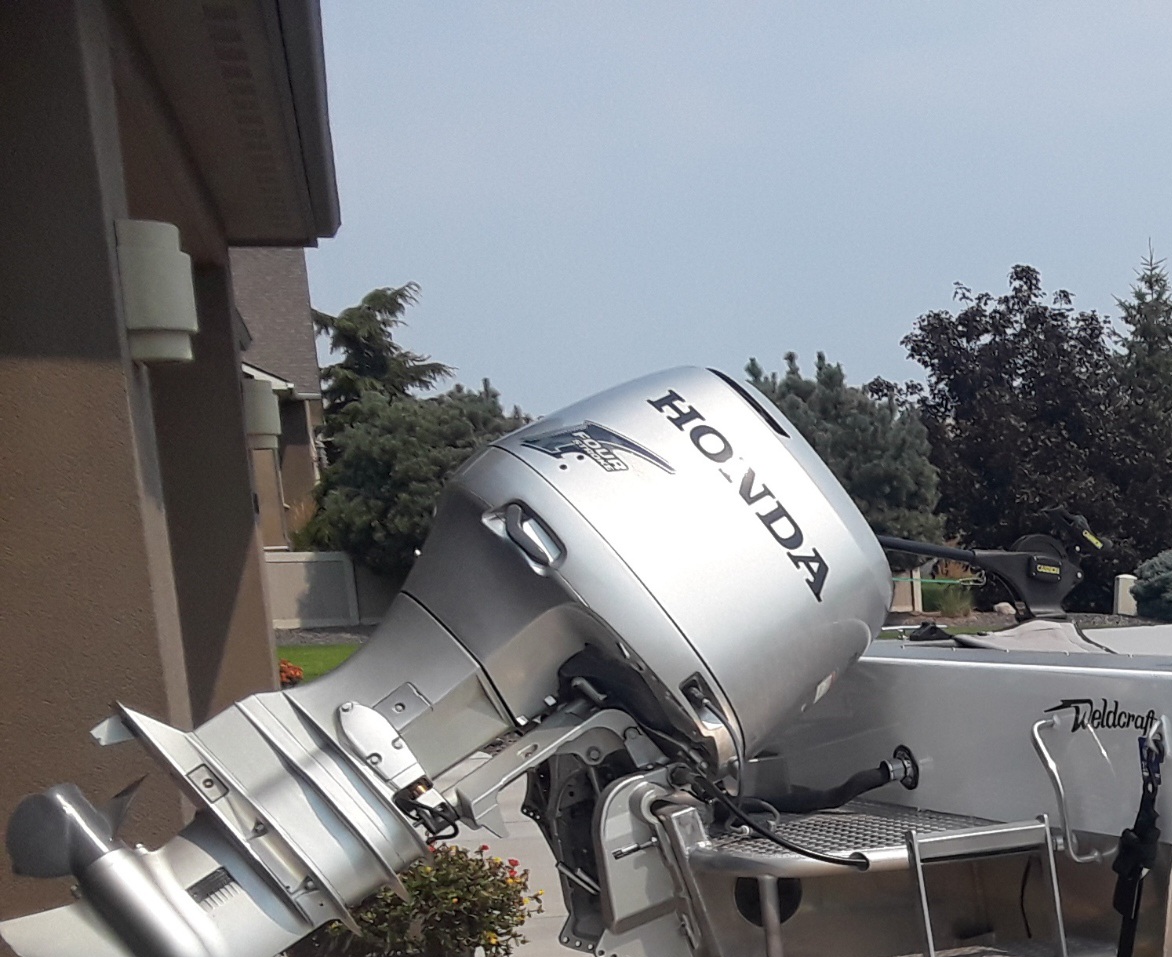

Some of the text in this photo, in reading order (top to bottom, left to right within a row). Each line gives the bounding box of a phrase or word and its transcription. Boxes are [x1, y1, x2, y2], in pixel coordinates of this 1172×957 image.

[572, 431, 623, 471] FOUR
[647, 389, 830, 603] HONDA
[1044, 698, 1158, 736] Weldcraft
